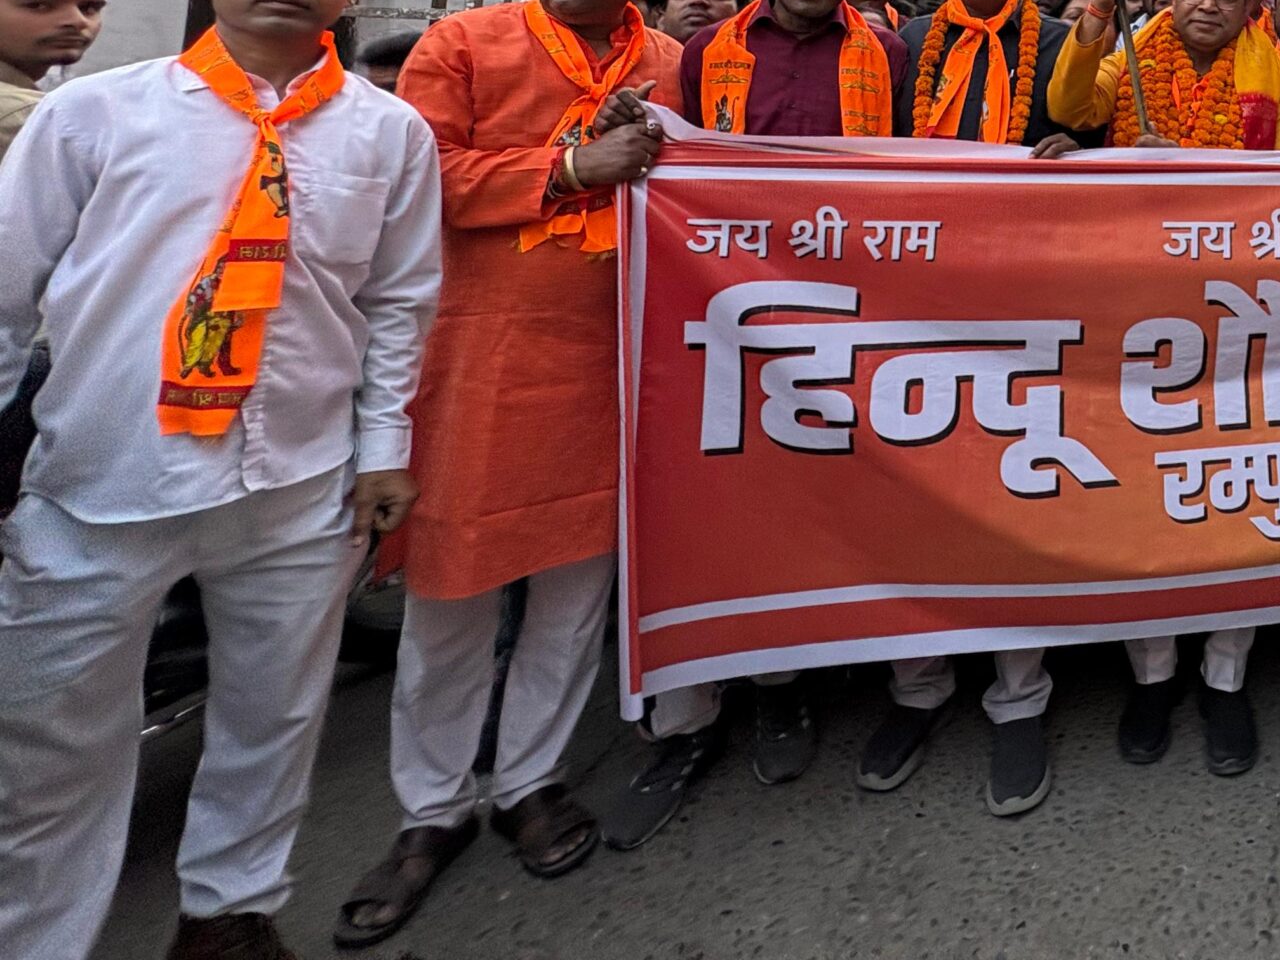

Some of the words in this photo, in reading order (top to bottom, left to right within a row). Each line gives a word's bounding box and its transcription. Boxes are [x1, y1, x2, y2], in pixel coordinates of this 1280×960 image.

[686, 218, 772, 258] जय
[787, 205, 848, 260] श्री
[863, 220, 942, 261] राम
[1162, 221, 1236, 259] जय
[684, 280, 1121, 500] हिन्दू
